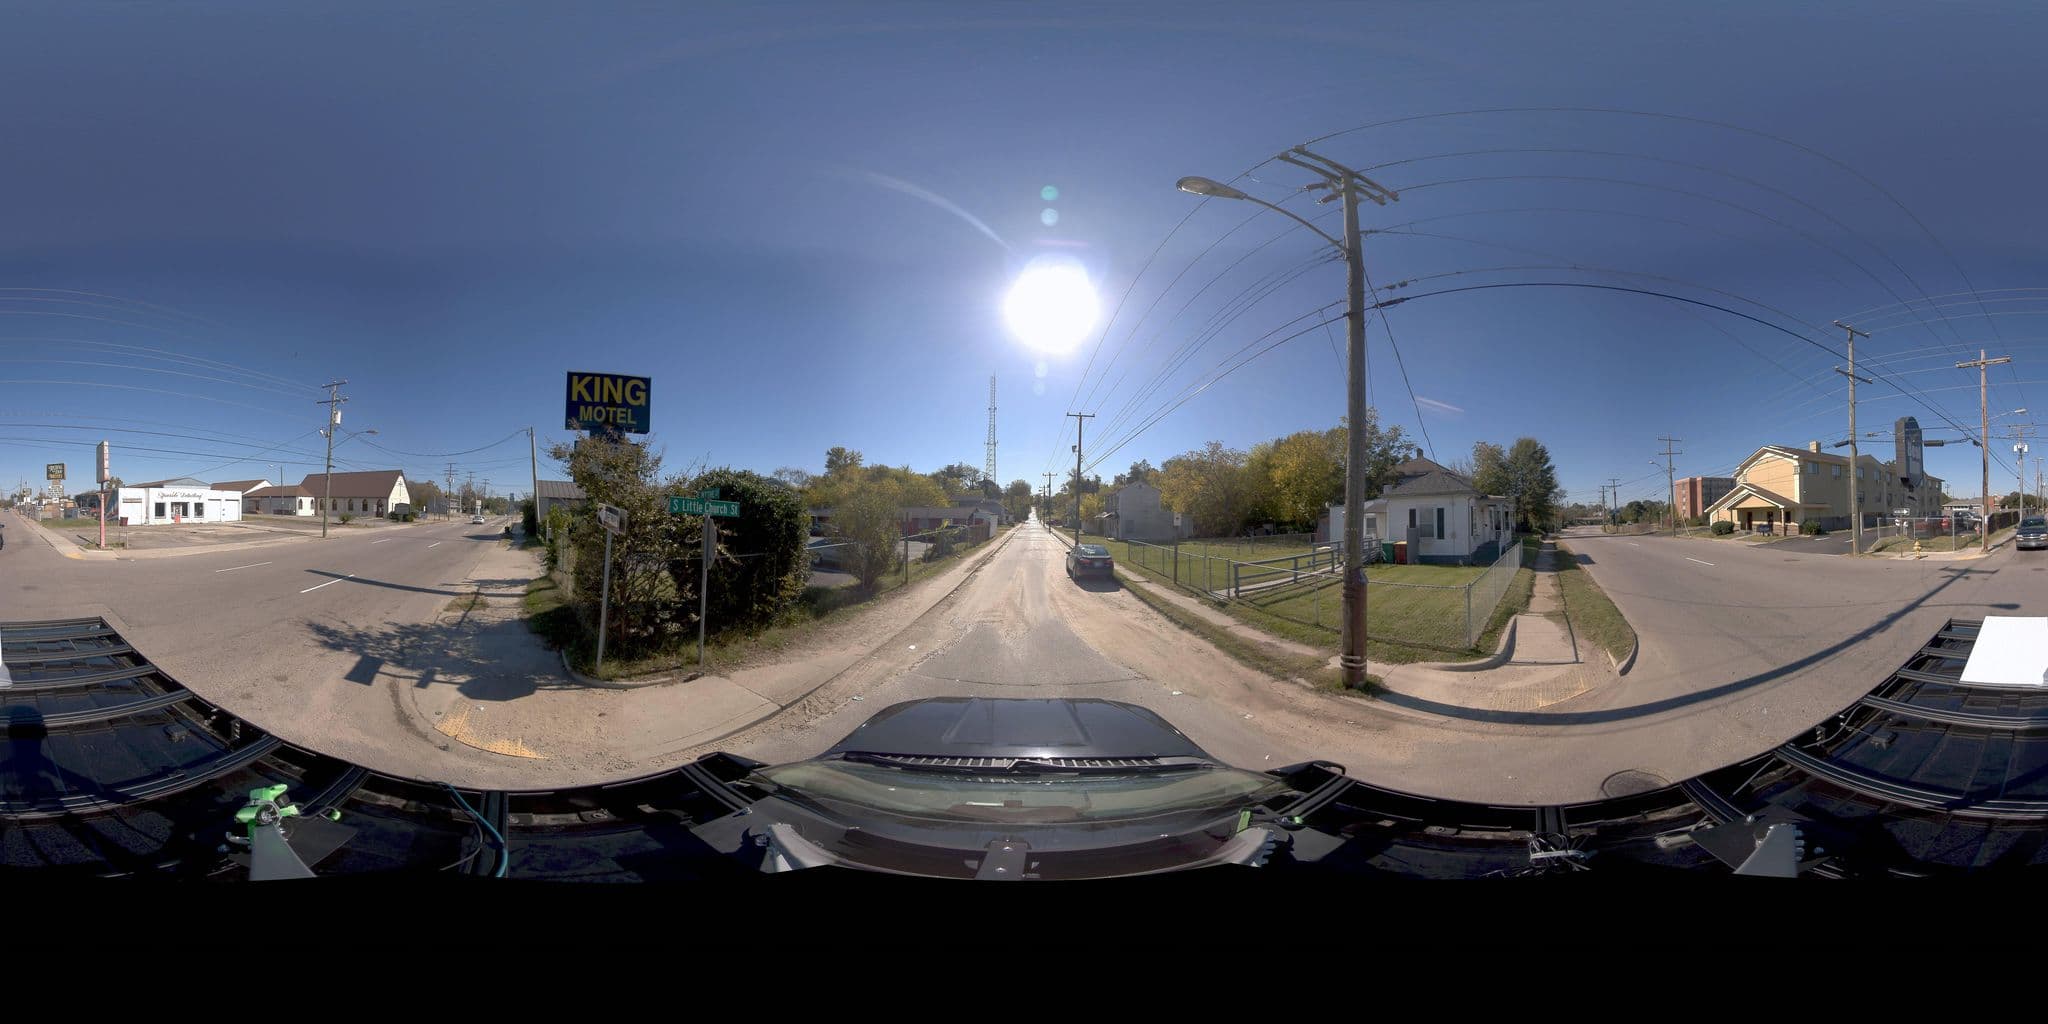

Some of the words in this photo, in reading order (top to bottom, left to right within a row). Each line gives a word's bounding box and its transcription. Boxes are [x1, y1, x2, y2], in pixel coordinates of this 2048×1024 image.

[571, 375, 647, 406] KING
[579, 405, 637, 425] MOTEL
[673, 499, 679, 511] S
[682, 499, 703, 513] Little
[704, 501, 728, 513] Church
[731, 504, 738, 515] St
